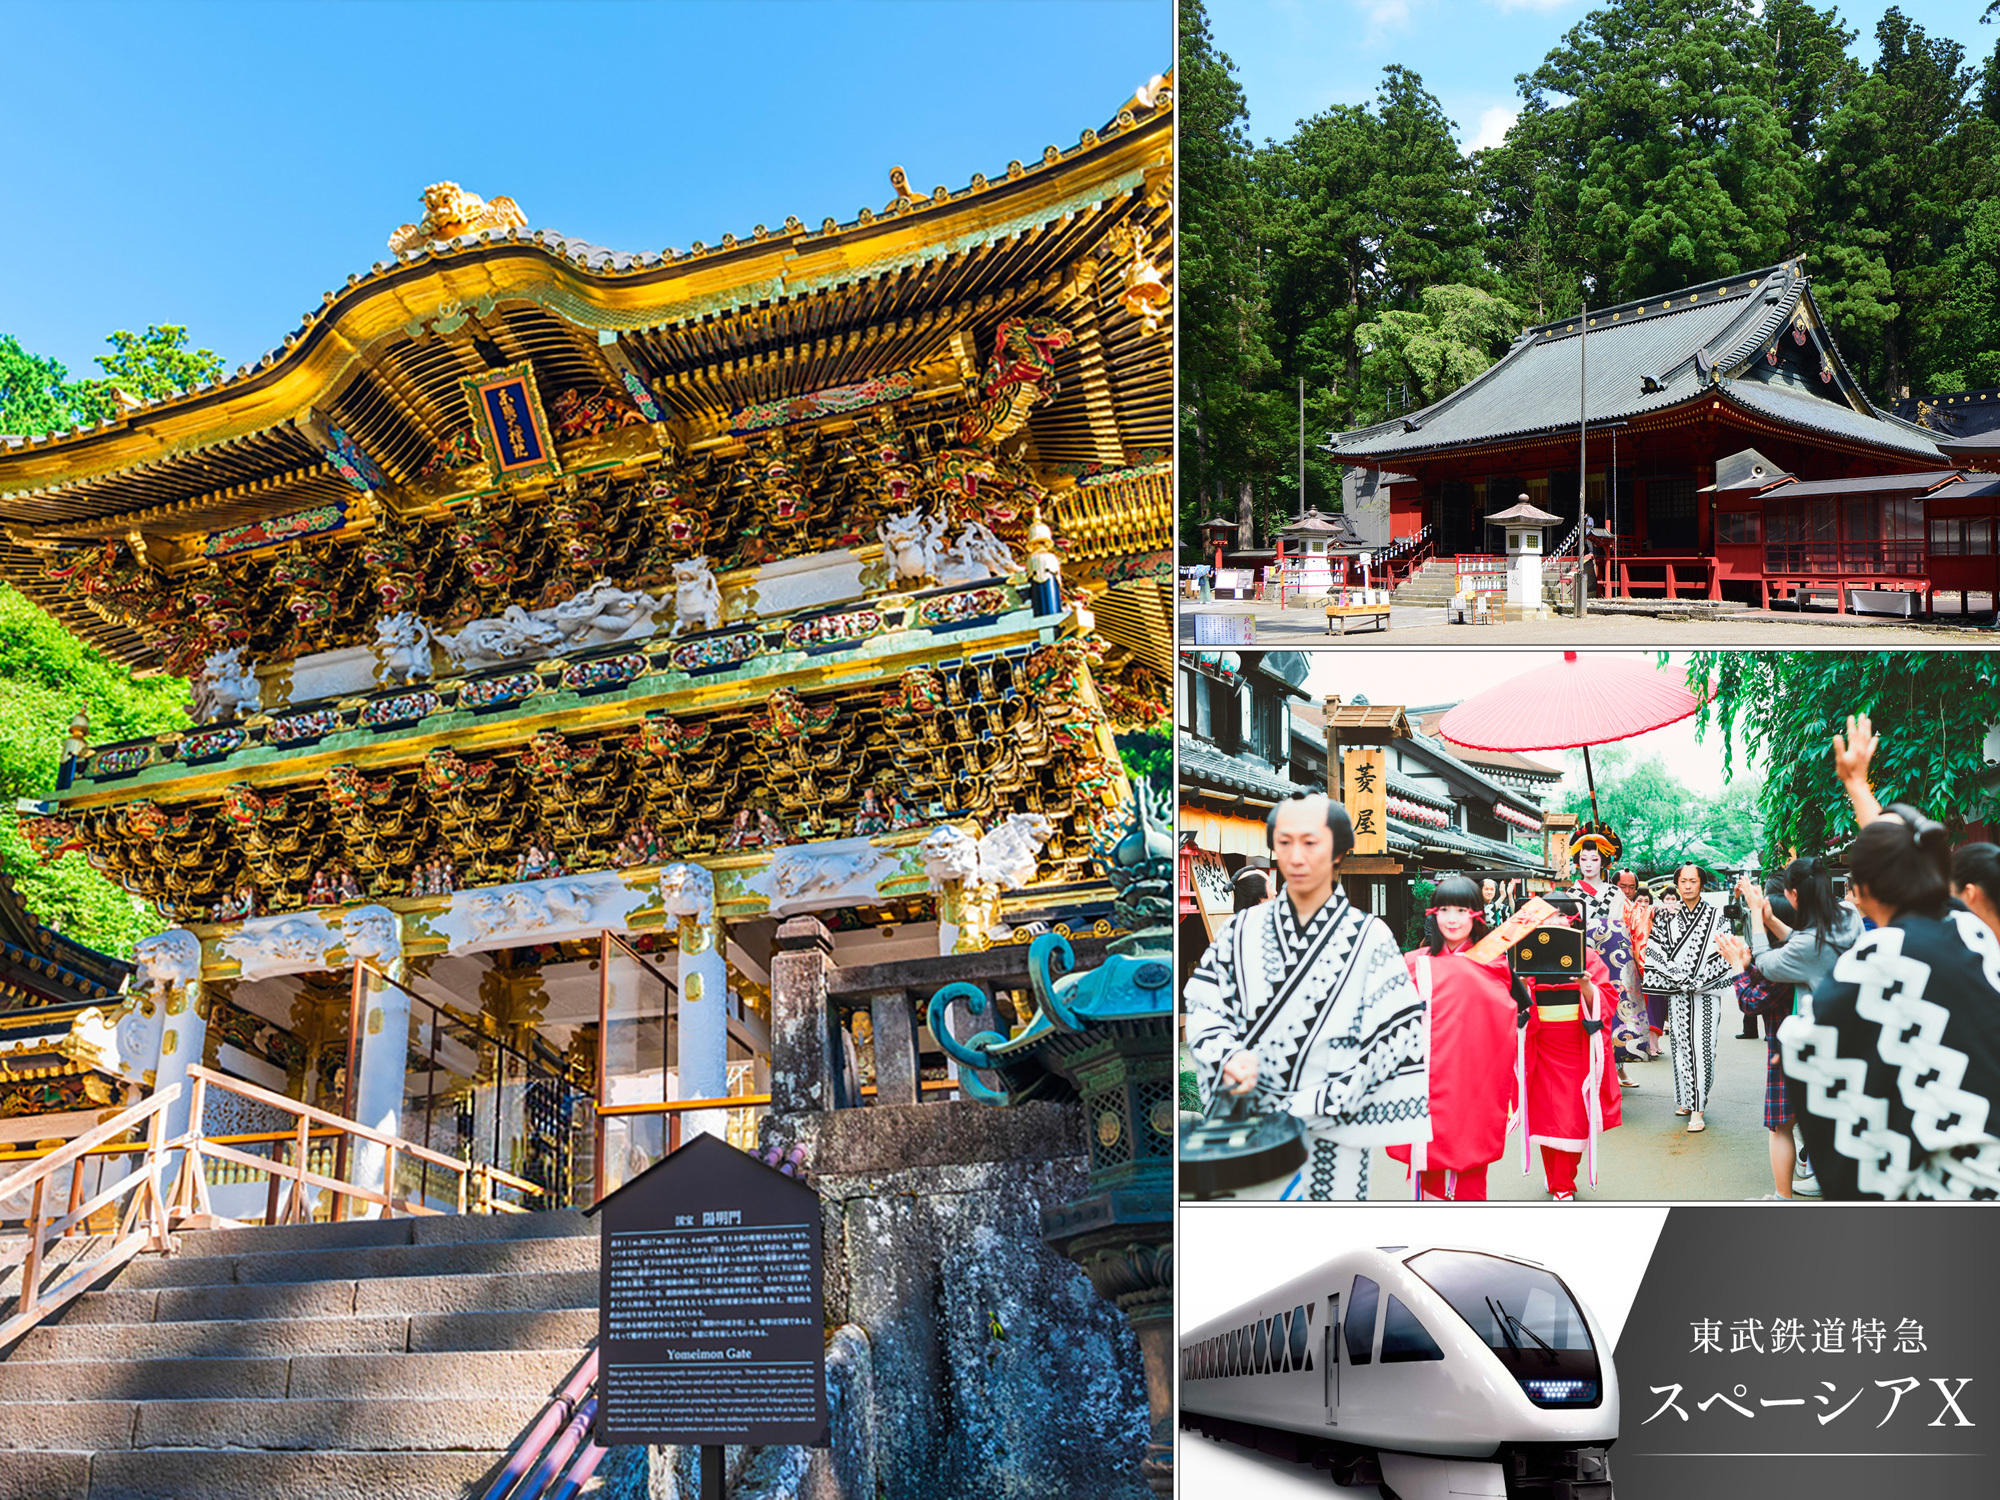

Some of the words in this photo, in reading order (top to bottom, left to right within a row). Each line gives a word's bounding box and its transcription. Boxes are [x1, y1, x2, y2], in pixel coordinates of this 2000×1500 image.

[1353, 762, 1377, 835] 菱屋
[702, 1209, 742, 1226] 陽明門
[666, 1348, 724, 1361] Yomeimon
[726, 1347, 753, 1360] Gate
